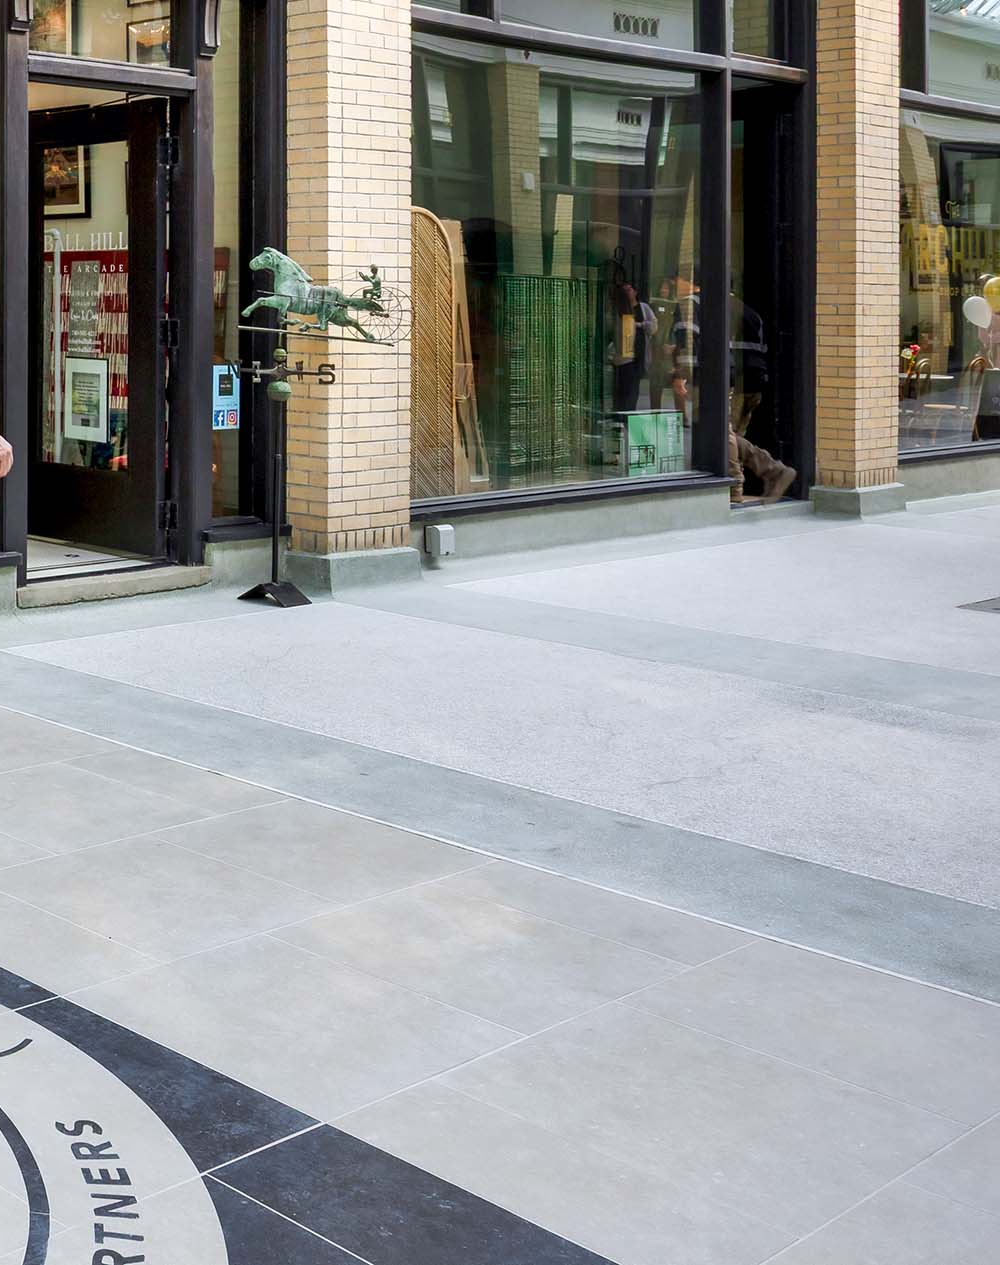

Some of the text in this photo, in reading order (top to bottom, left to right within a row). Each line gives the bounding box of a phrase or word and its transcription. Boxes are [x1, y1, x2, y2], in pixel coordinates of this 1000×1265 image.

[89, 231, 128, 251] HILL
[76, 263, 124, 273] ARCADE
[318, 363, 336, 384] S
